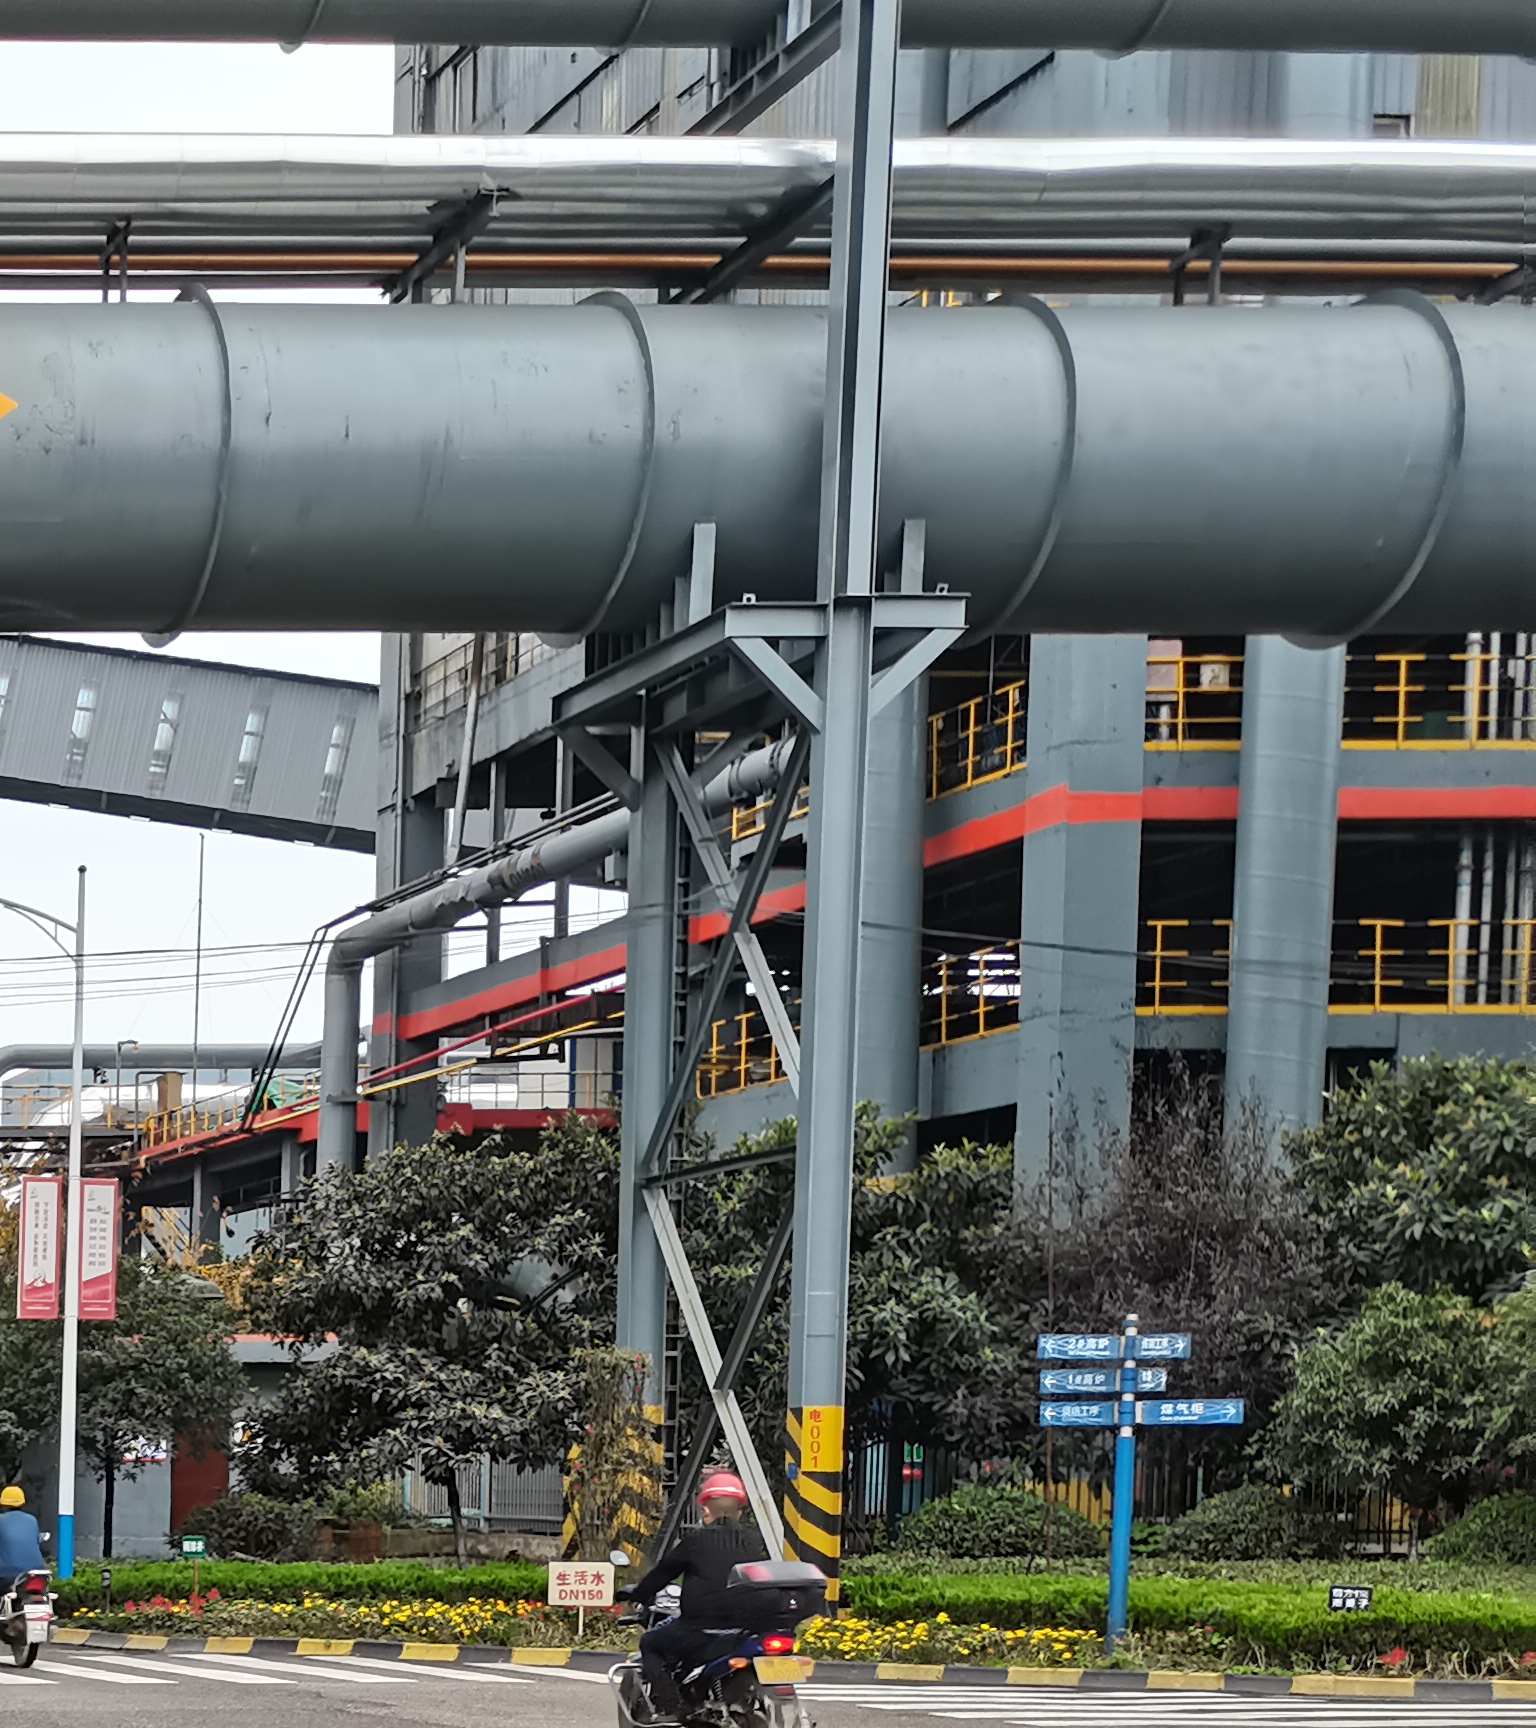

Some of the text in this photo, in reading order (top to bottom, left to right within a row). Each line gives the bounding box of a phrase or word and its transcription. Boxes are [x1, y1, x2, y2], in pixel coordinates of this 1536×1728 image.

[810, 1409, 822, 1468] 电001
[556, 1570, 605, 1586] 生活水
[558, 1589, 604, 1601] DN150
